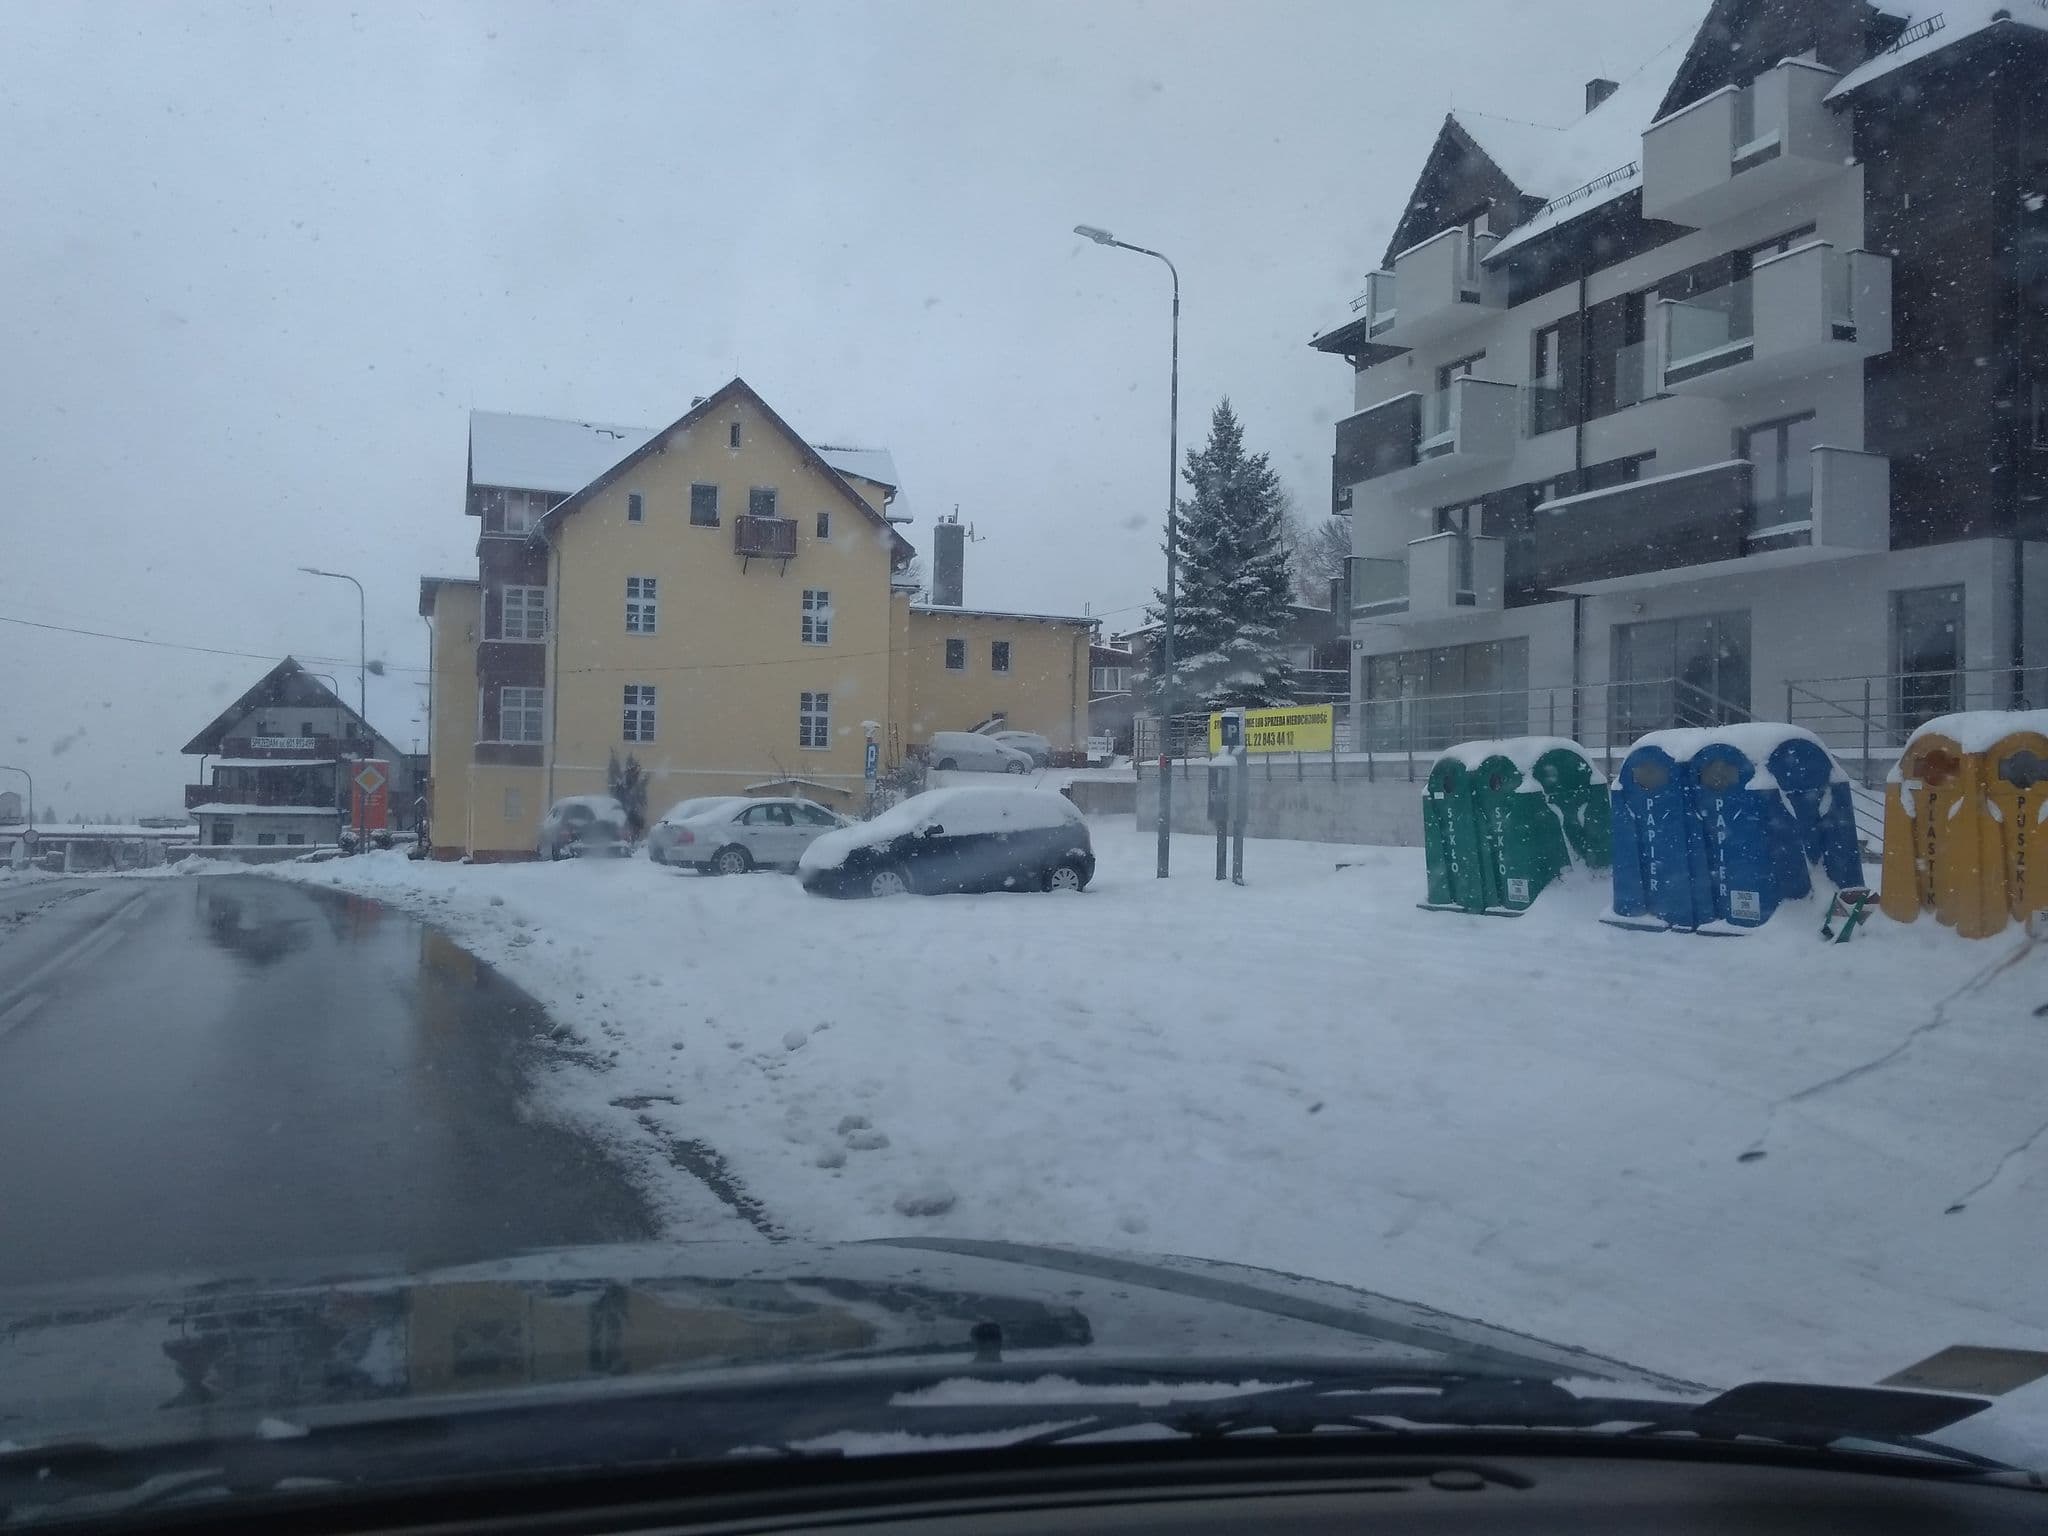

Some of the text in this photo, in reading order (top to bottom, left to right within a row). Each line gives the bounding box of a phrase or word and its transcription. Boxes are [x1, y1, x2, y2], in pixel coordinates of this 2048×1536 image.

[1227, 724, 1238, 738] P
[1254, 733, 1261, 746] 22
[1262, 732, 1275, 746] 843
[1276, 731, 1285, 746] 44
[1255, 717, 1264, 727] LUB
[1264, 716, 1285, 727] SPRZEDA
[867, 745, 876, 768] P
[1447, 808, 1459, 873] SZKŁO
[1495, 807, 1506, 875] SZKŁO
[1646, 798, 1658, 891] PAPIER
[1715, 799, 1728, 897] PAPIER
[1927, 793, 1937, 905] PLASTIK
[2016, 796, 2026, 902] PUSZKI
